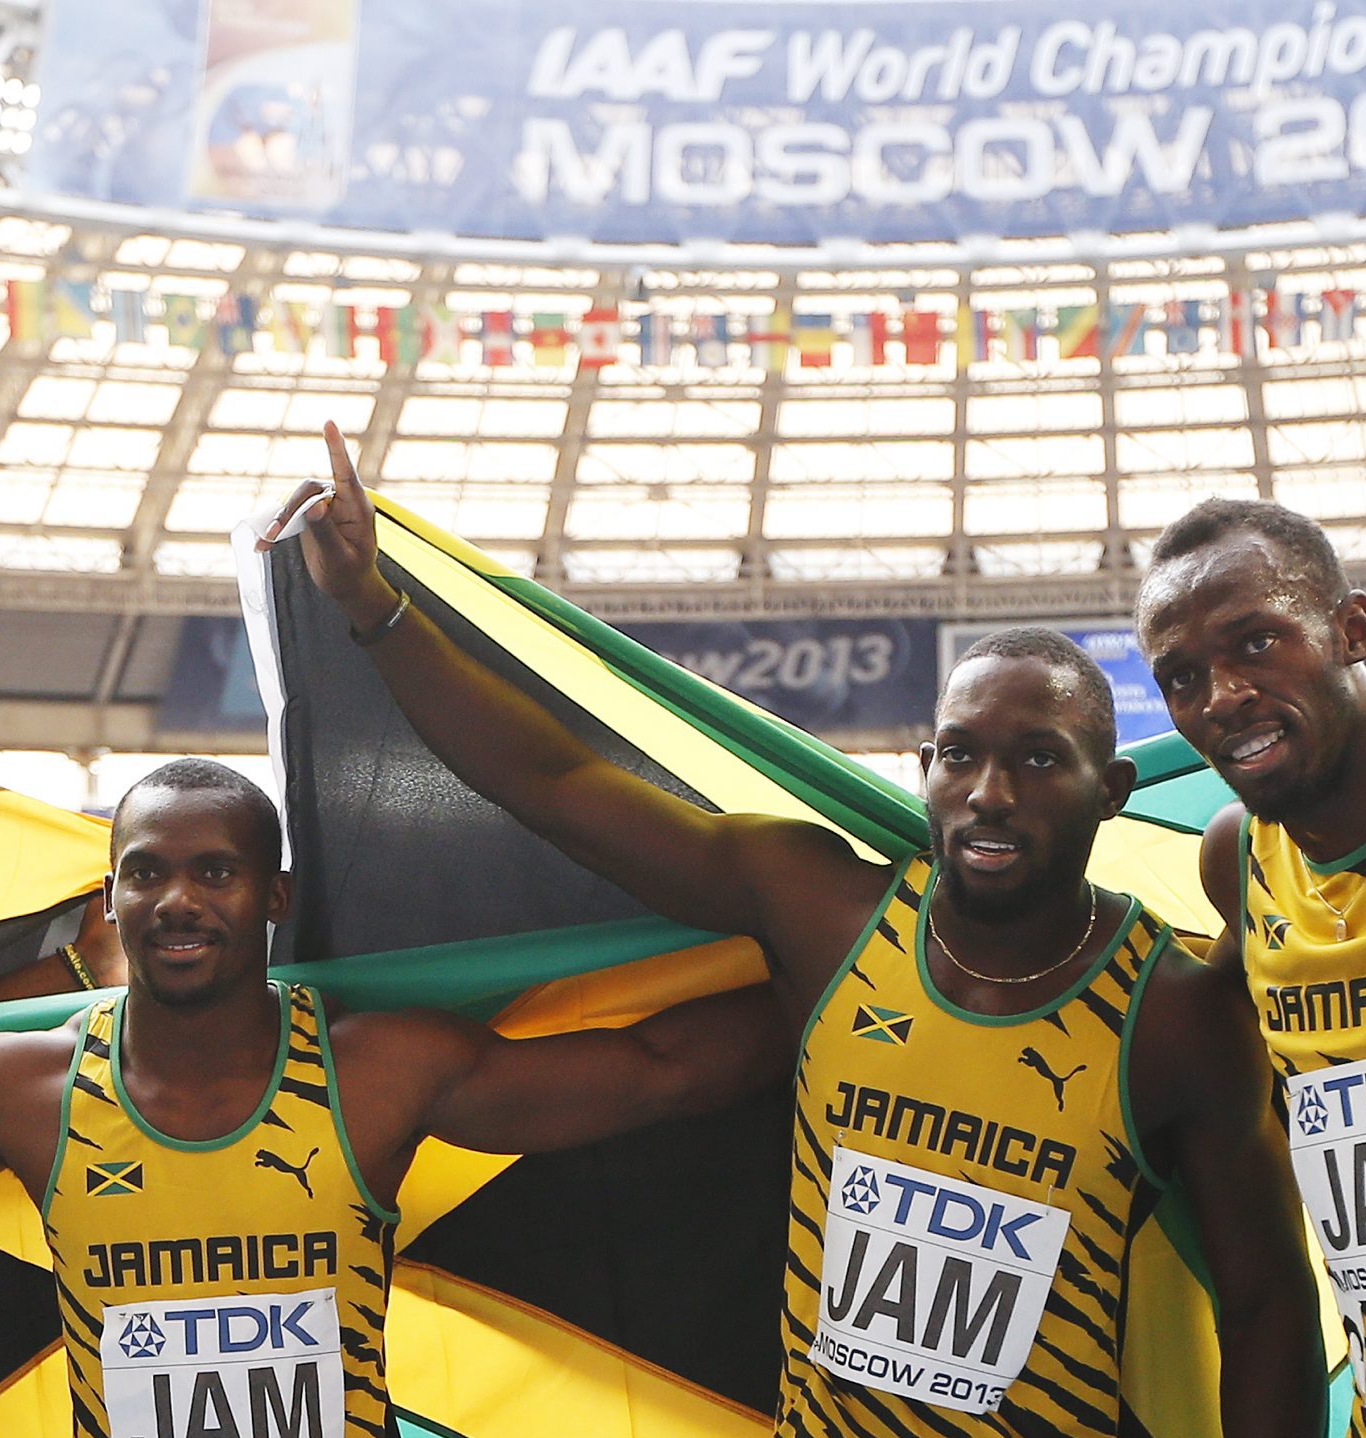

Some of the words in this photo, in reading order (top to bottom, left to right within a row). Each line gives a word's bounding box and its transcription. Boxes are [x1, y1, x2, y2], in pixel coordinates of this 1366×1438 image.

[528, 26, 776, 102] IAAF
[788, 24, 1022, 102] World
[519, 104, 1214, 205] MOSCOW
[825, 1081, 1076, 1189] JAMAICA
[84, 1231, 336, 1288] JAMAICA
[886, 1173, 1043, 1261] TDK
[164, 1301, 320, 1355] TDK
[827, 1230, 1022, 1366] JAM
